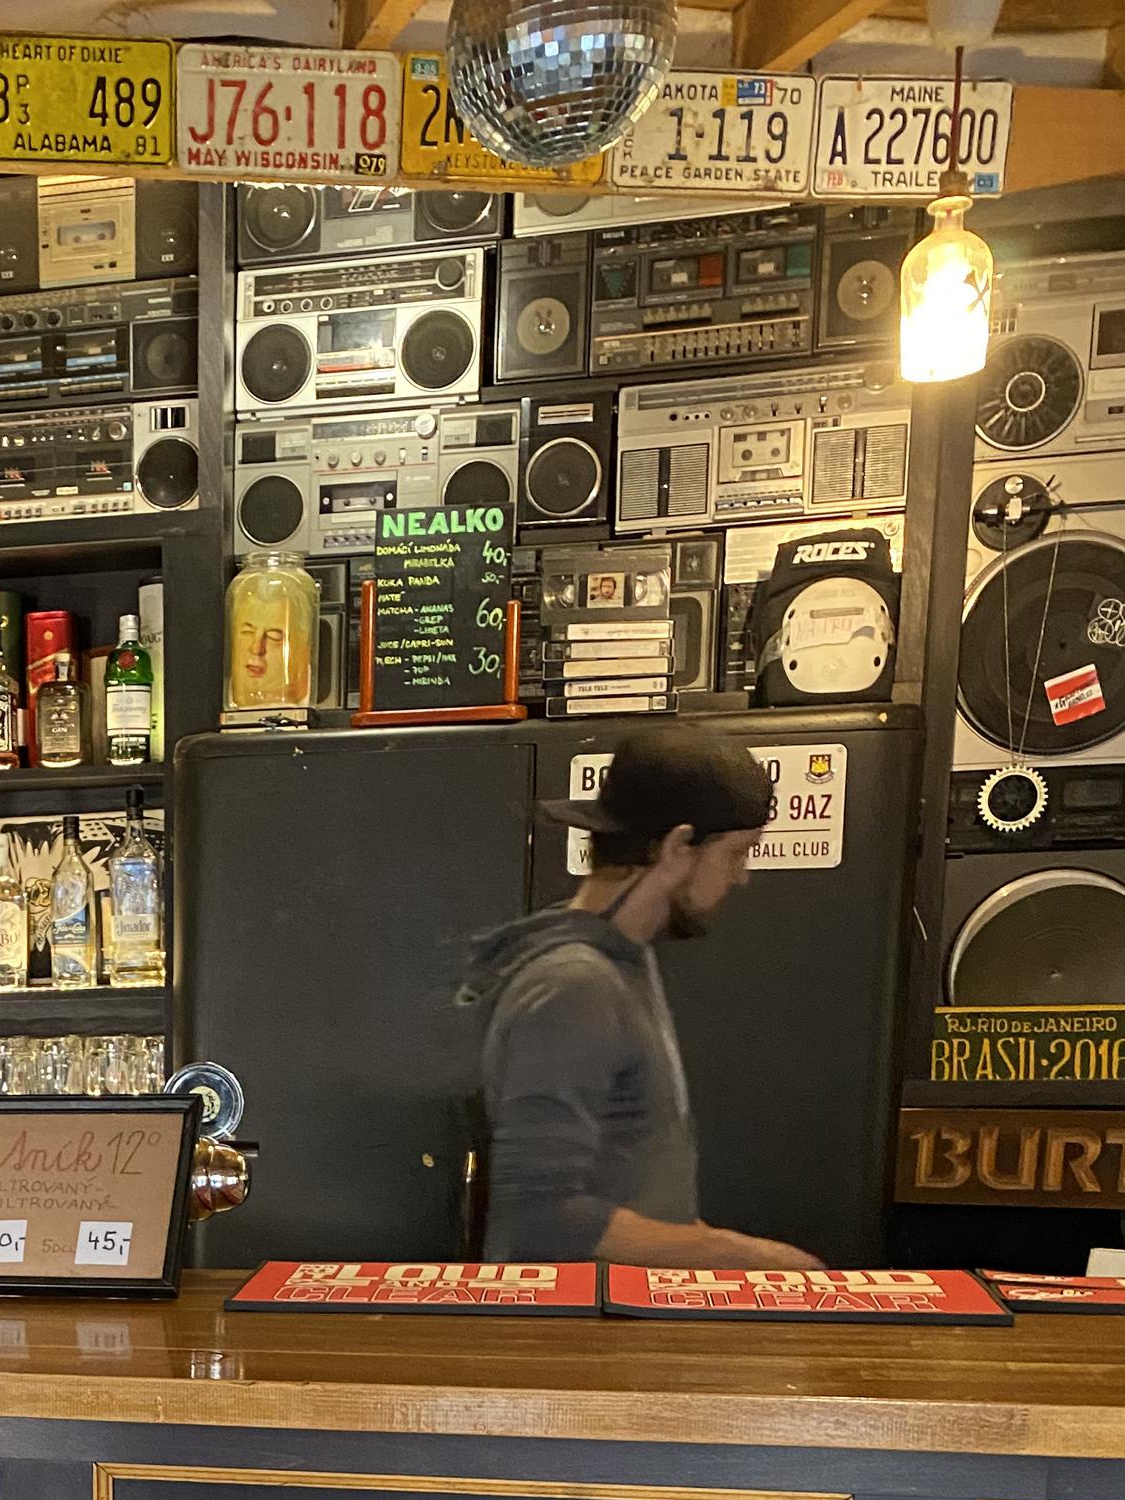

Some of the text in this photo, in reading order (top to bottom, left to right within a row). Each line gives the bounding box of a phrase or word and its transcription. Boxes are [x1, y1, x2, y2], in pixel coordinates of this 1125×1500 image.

[1, 43, 124, 64] HEART OF DIXIE
[202, 52, 378, 74] AMERICA'S DAIRYLAND
[662, 84, 718, 101] AKOTA
[891, 86, 944, 103] MAINE
[13, 132, 161, 156] ALABAMA 81
[187, 147, 341, 170] MAY WISCONSIN
[620, 166, 802, 184] PEACE GARDEN STATE
[826, 172, 844, 188] FEB
[871, 171, 939, 188] TRAILE
[382, 507, 504, 538] NEALKO
[792, 541, 870, 564] ROCES
[789, 794, 833, 821] 9AZ
[792, 841, 830, 857] CLUB
[1011, 1021, 1032, 1032] DE
[1033, 1016, 1118, 1033] JANEIRO
[336, 1263, 558, 1283] LOUD
[694, 1269, 935, 1287] LOUD
[380, 1280, 454, 1288] AND
[752, 1284, 841, 1294] AND
[274, 1286, 539, 1305] CLEAR
[650, 1291, 942, 1313] CLEAR
